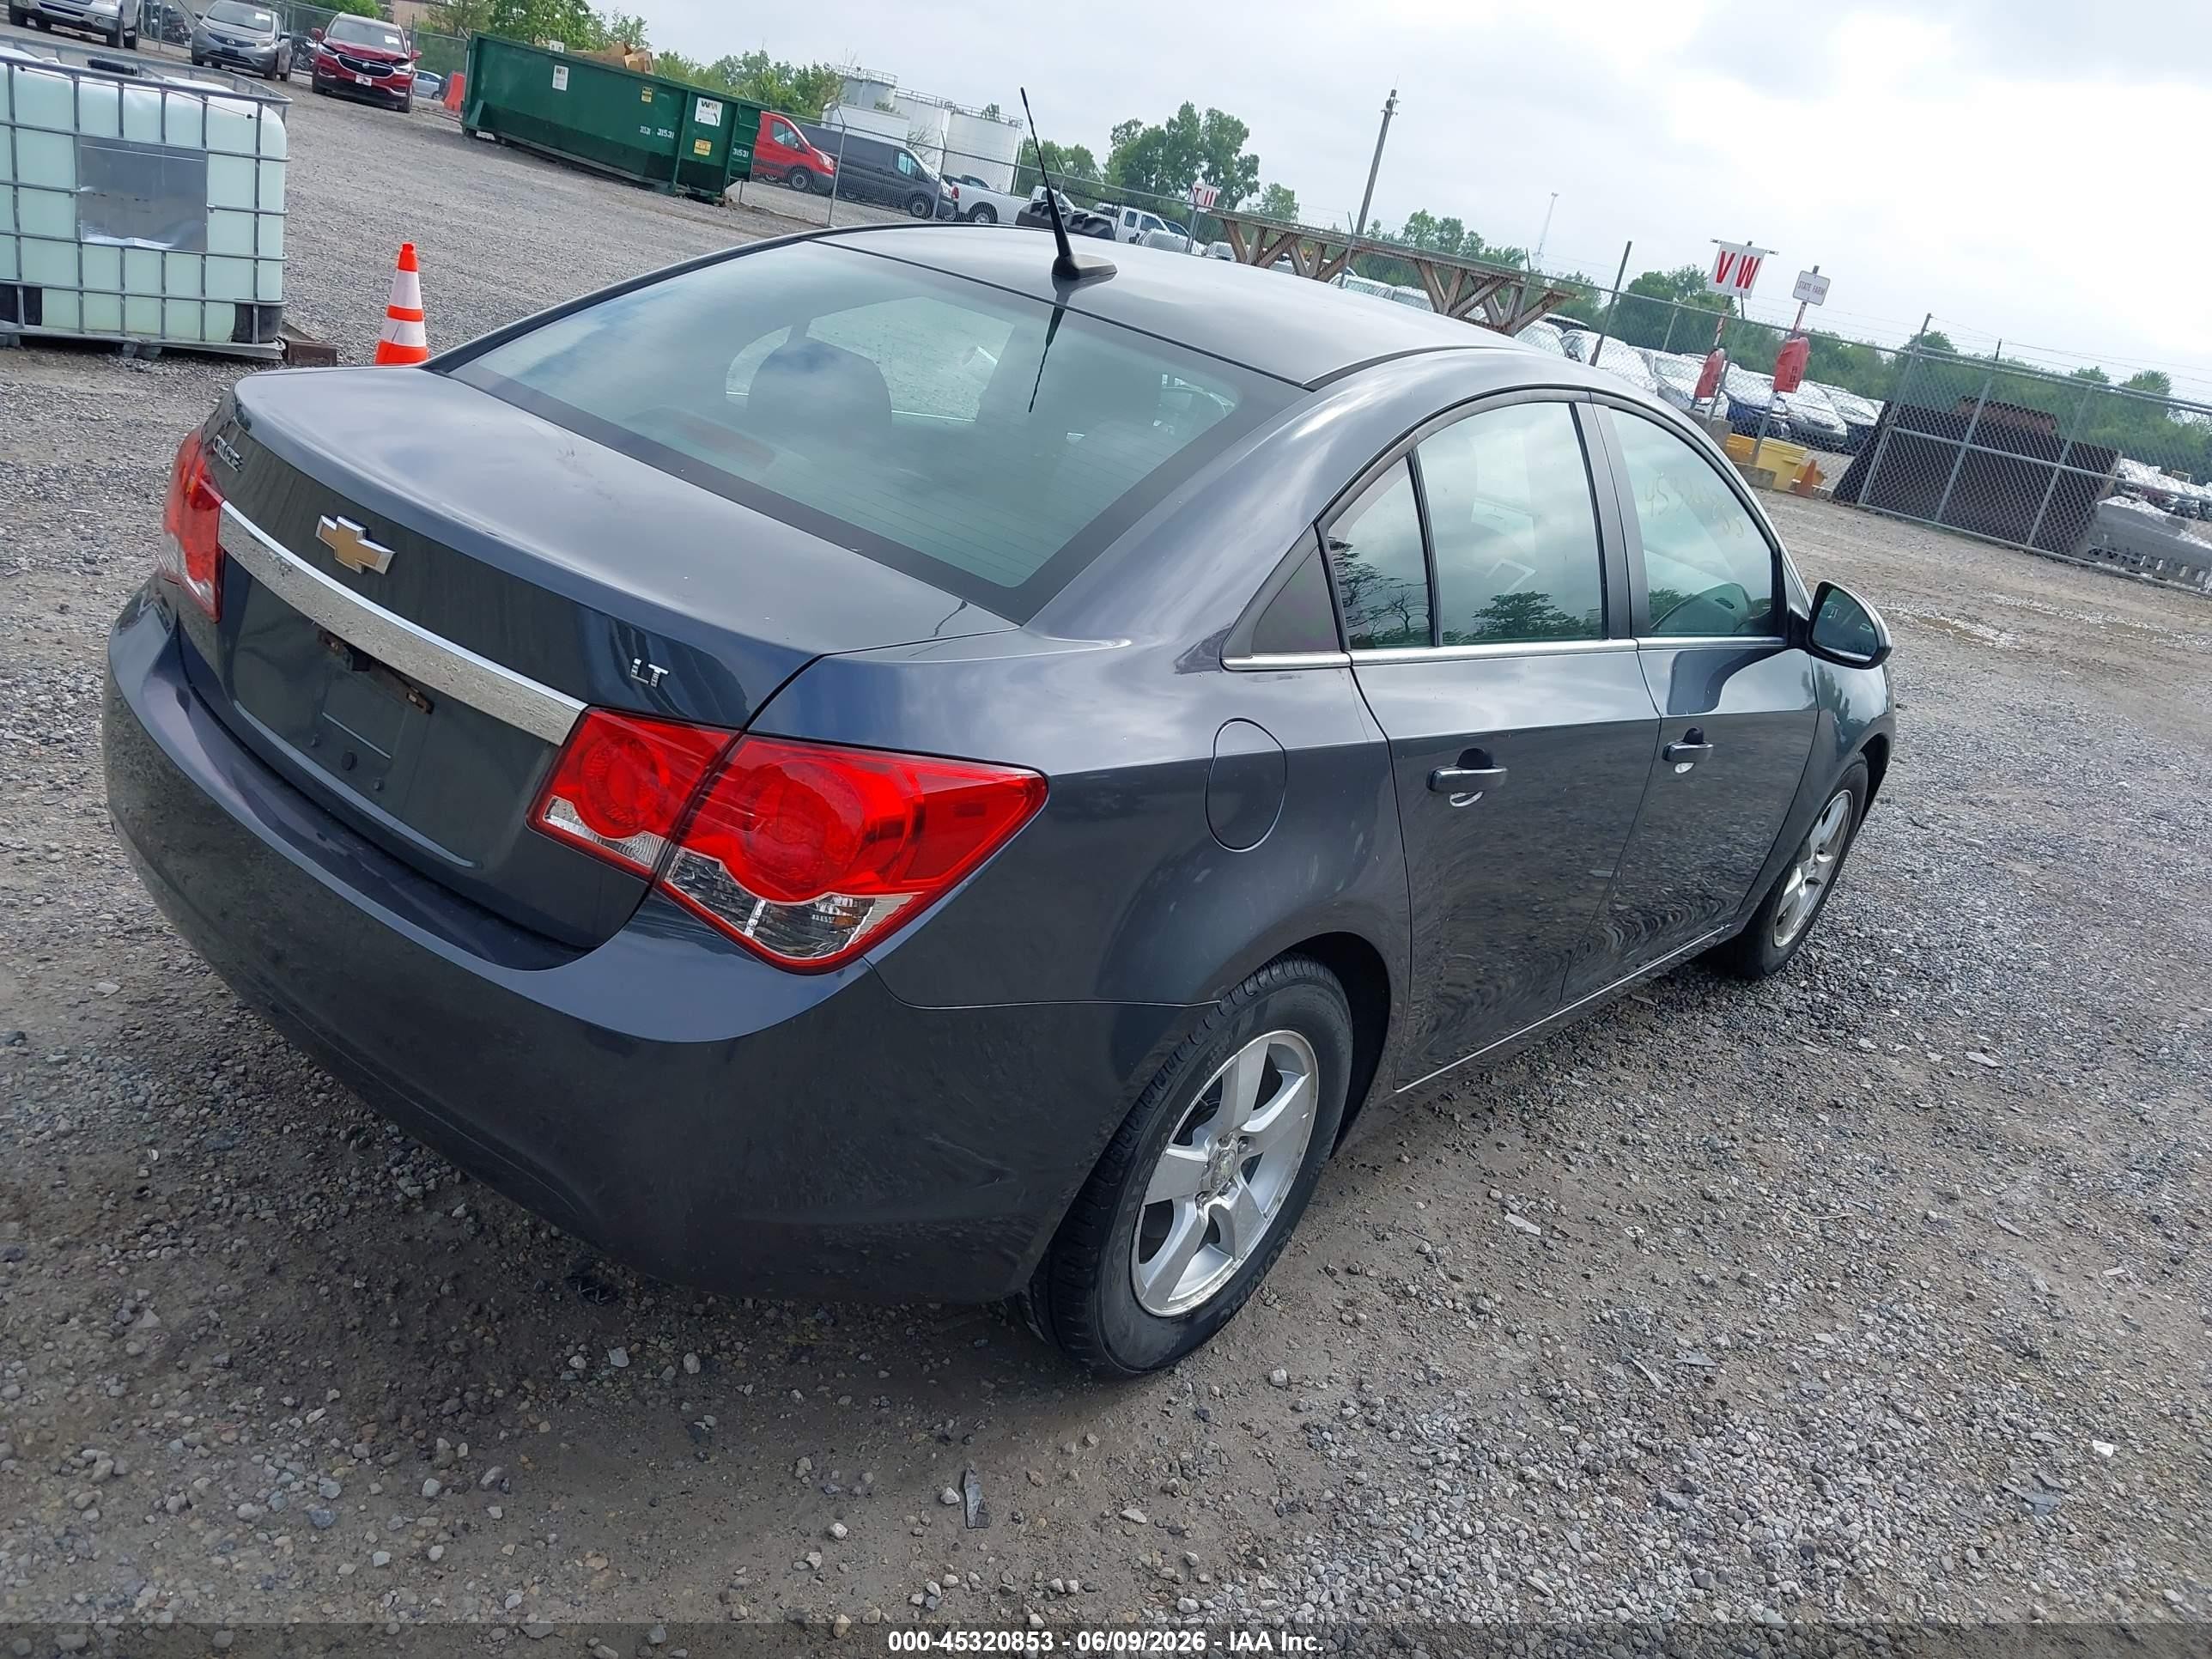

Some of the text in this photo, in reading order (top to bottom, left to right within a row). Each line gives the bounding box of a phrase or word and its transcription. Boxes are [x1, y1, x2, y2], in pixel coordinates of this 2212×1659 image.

[657, 128, 675, 139] 31531
[732, 148, 750, 158] 31531
[1797, 280, 1826, 295] STATE FARM
[630, 658, 669, 688] LT
